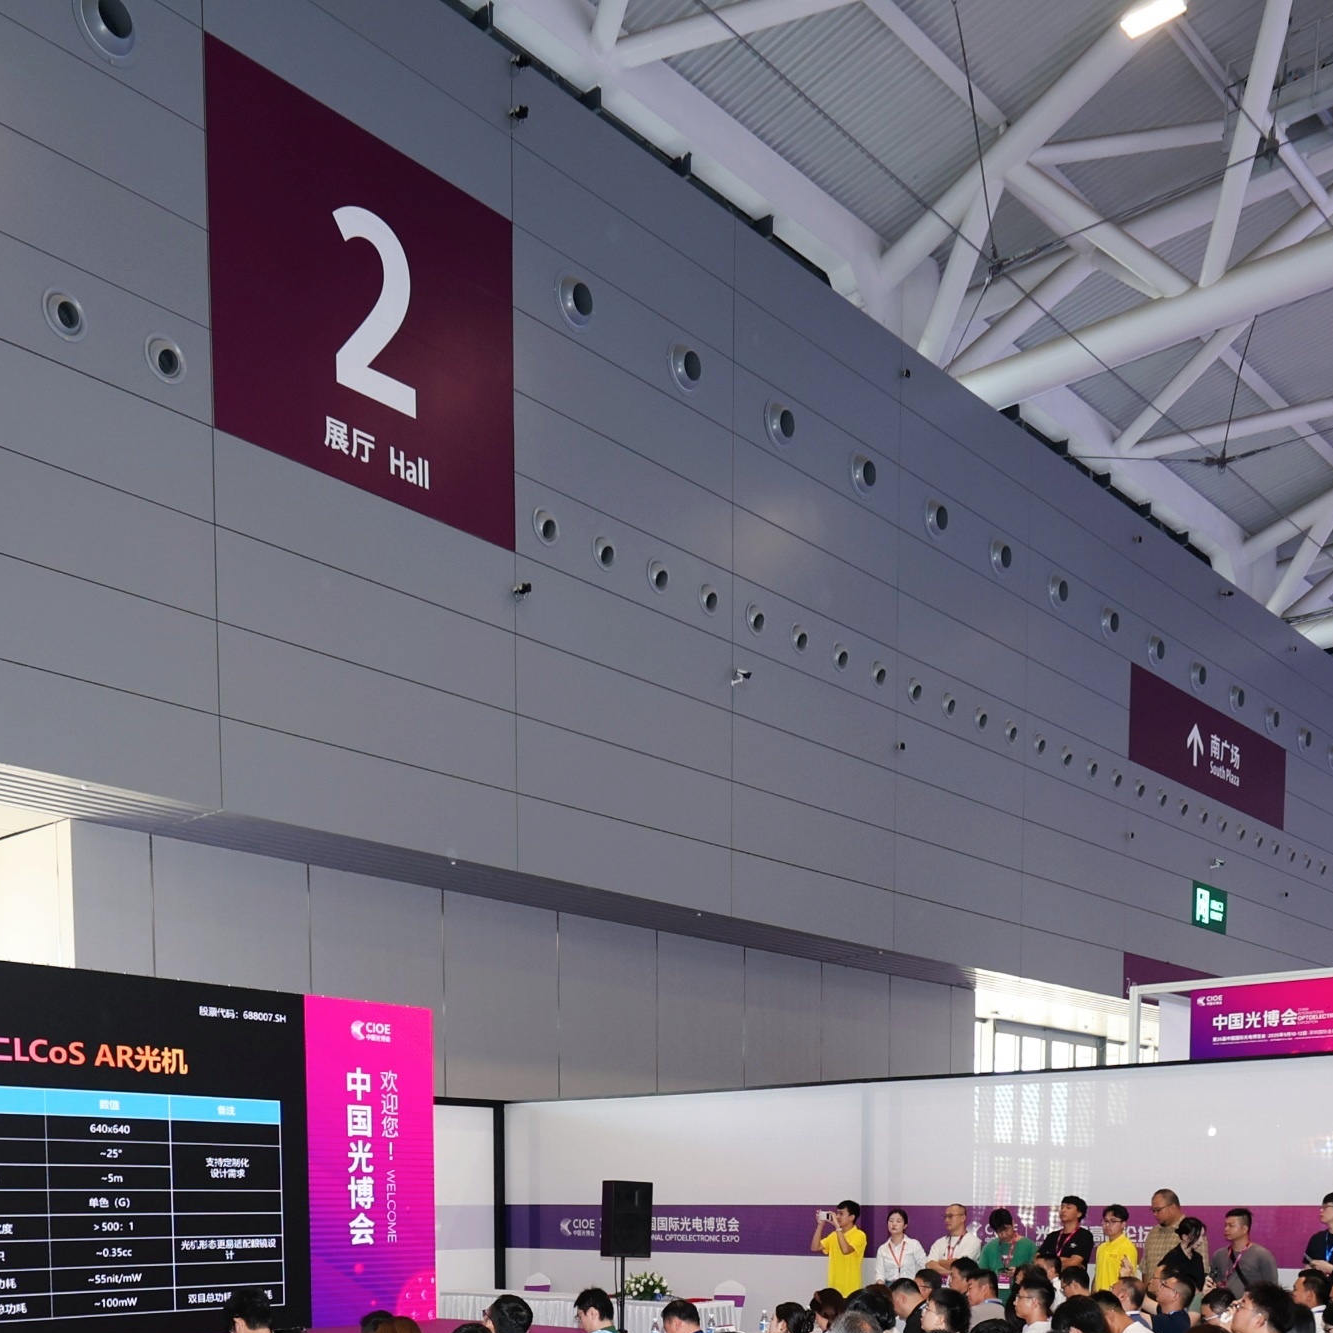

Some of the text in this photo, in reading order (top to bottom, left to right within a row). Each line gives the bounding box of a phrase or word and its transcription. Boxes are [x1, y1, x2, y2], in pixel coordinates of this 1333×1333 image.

[332, 205, 417, 420] 2
[324, 416, 430, 490] 展厅 Hall
[1210, 733, 1241, 770] 南广场
[1209, 760, 1240, 787] South Plaza
[1212, 1008, 1298, 1031] 中国光博会
[365, 1021, 392, 1035] CIOE
[94, 1044, 189, 1076] AR光机
[89, 1124, 131, 1135] 640x640
[100, 1149, 123, 1159] ~25°
[346, 1066, 376, 1246] 中国光博会
[380, 1069, 399, 1243] 欢迎您！ WELCOME
[205, 1157, 250, 1169] 支持定制化
[101, 1174, 123, 1183] ~5m
[209, 1168, 246, 1179] 设计需求
[572, 1218, 596, 1229] CIOE
[572, 1229, 596, 1237] 中国光博会
[665, 1234, 720, 1243] OPTOELECTRONIC
[96, 1248, 133, 1258] ~0.35cc
[88, 1272, 143, 1284] ~55nit/mW
[94, 1297, 138, 1308] ~100mW
